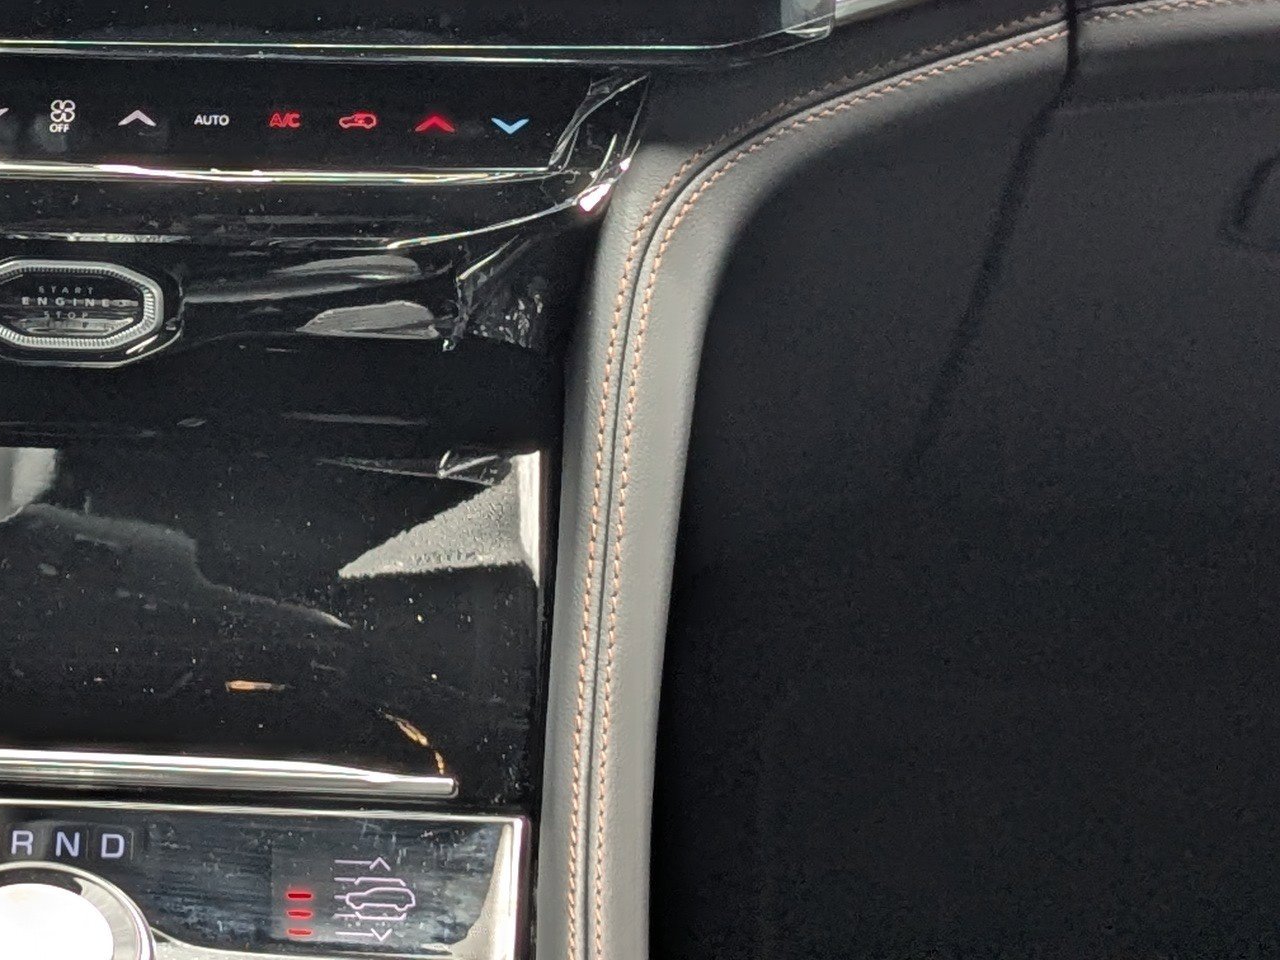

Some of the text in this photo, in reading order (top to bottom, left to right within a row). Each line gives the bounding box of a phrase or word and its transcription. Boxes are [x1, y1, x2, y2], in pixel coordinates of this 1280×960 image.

[194, 114, 230, 127] AUTO
[269, 112, 301, 128] A/C
[49, 123, 70, 133] OFF
[39, 286, 93, 294] START
[22, 296, 110, 307] ENGINE
[44, 311, 88, 319] STOP
[11, 830, 32, 855] R
[57, 832, 80, 857] N
[101, 832, 125, 858] D
